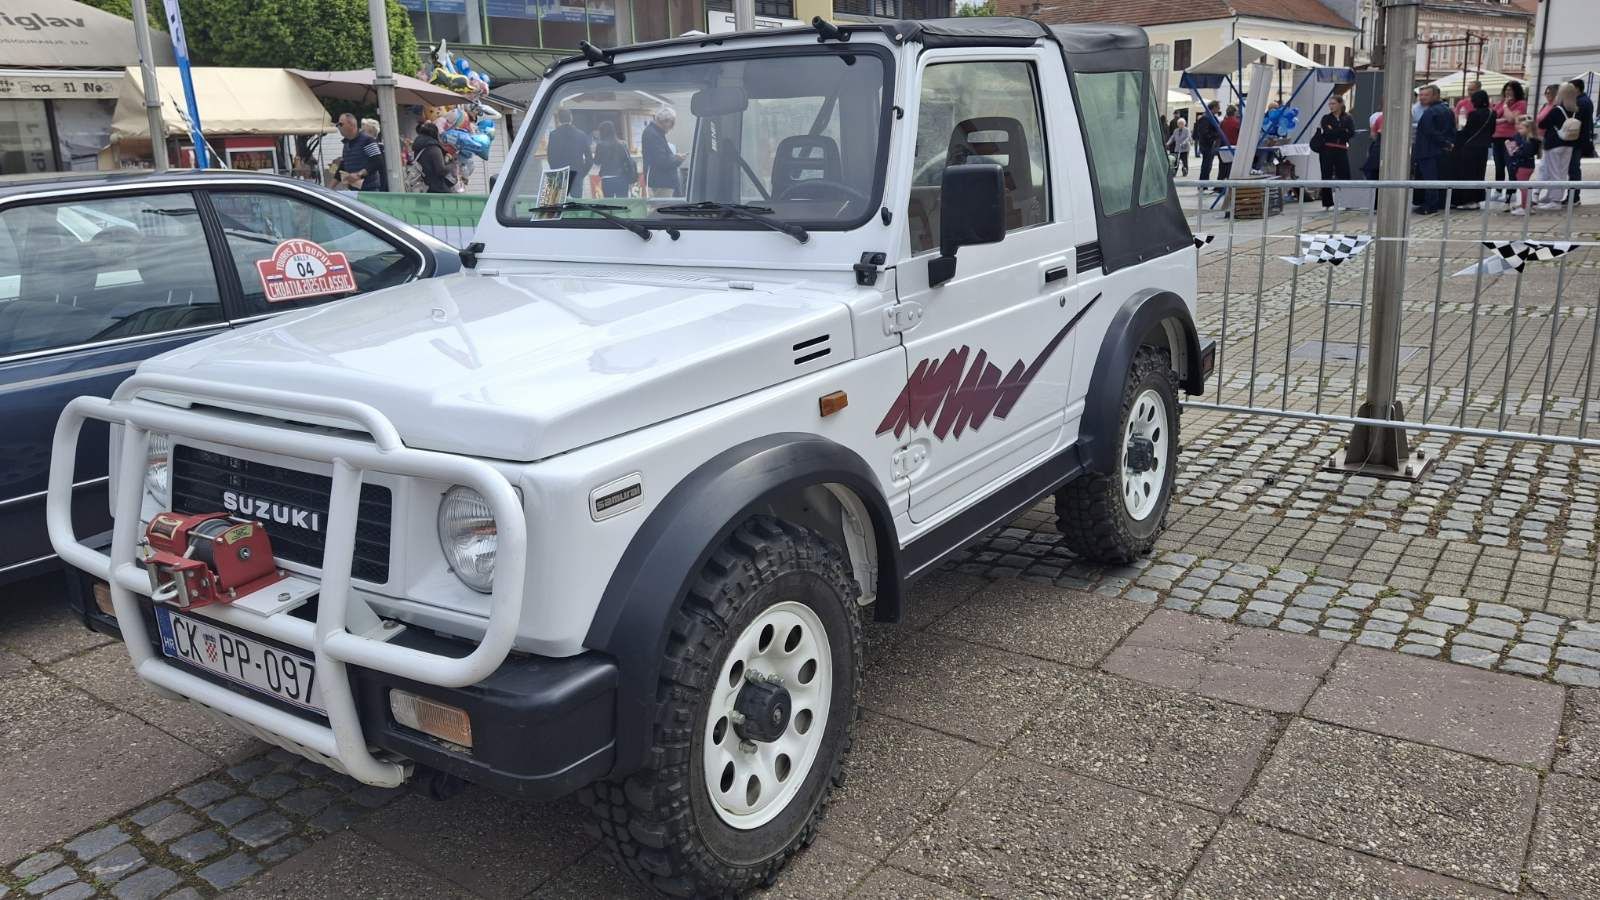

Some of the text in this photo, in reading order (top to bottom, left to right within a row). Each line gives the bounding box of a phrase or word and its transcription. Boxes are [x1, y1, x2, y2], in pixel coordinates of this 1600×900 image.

[0, 12, 85, 31] iglav
[296, 262, 314, 277] 04
[268, 274, 351, 298] CROATIA 2025 CLASSIC
[223, 491, 320, 532] SUZUKI
[163, 636, 176, 650] HR
[173, 617, 316, 704] ČK PP-097
